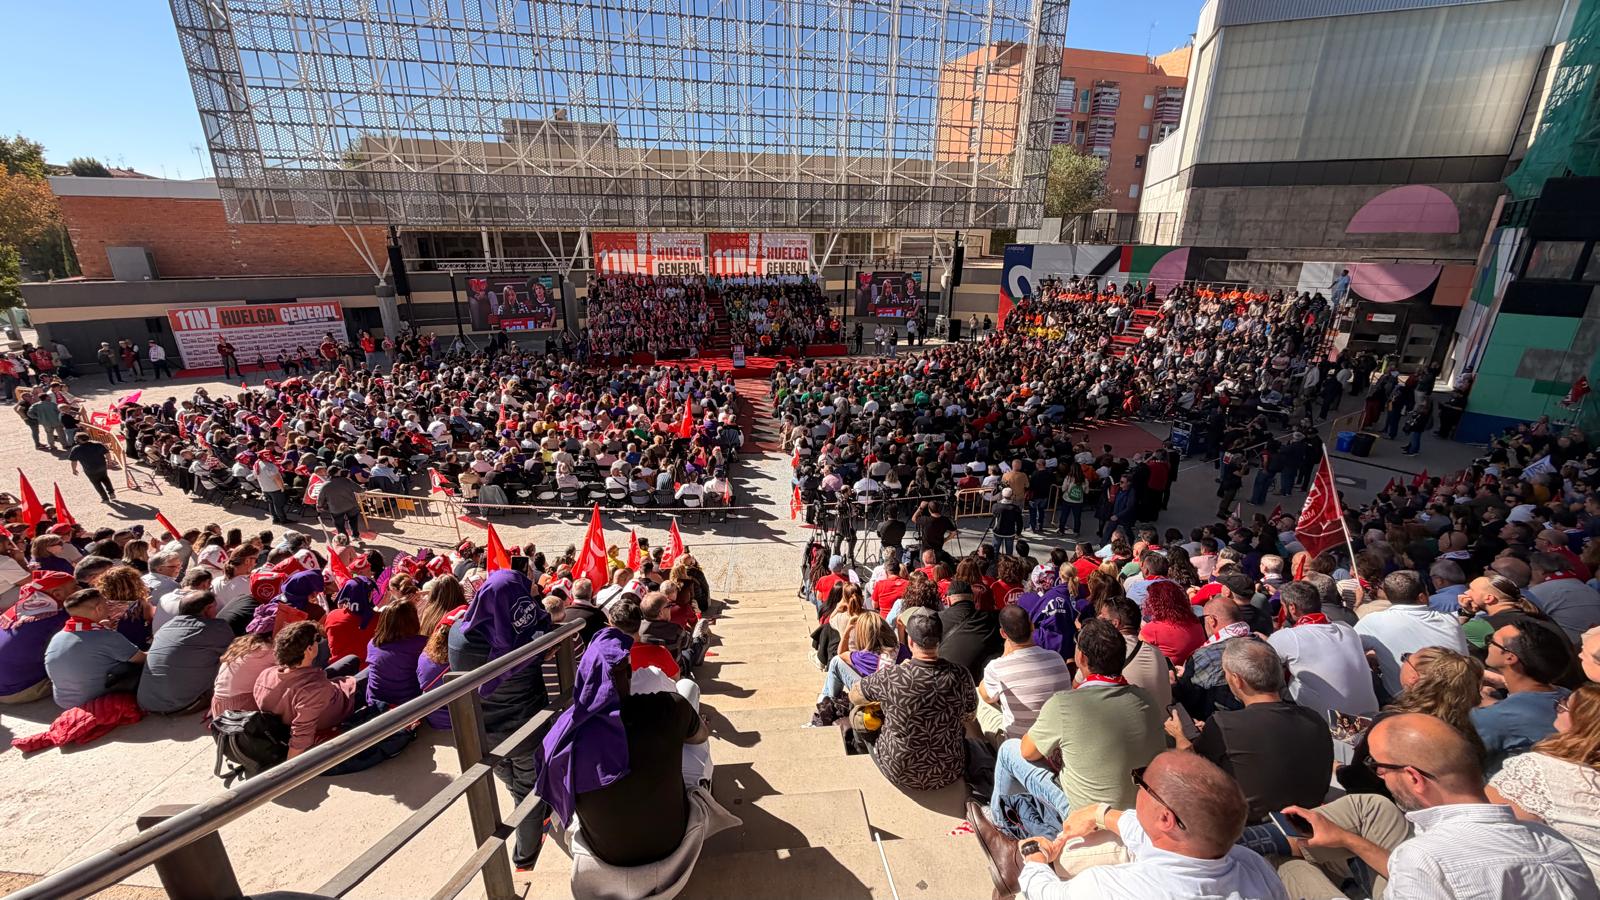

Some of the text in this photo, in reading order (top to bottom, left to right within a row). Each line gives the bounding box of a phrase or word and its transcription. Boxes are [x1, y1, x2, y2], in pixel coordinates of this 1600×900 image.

[657, 246, 702, 260] HUELGA
[766, 246, 808, 260] HUELGA
[658, 262, 702, 275] GENERAL
[767, 262, 808, 274] GENERAL
[220, 308, 276, 325] HUELGA
[280, 305, 339, 322] GENERAL
